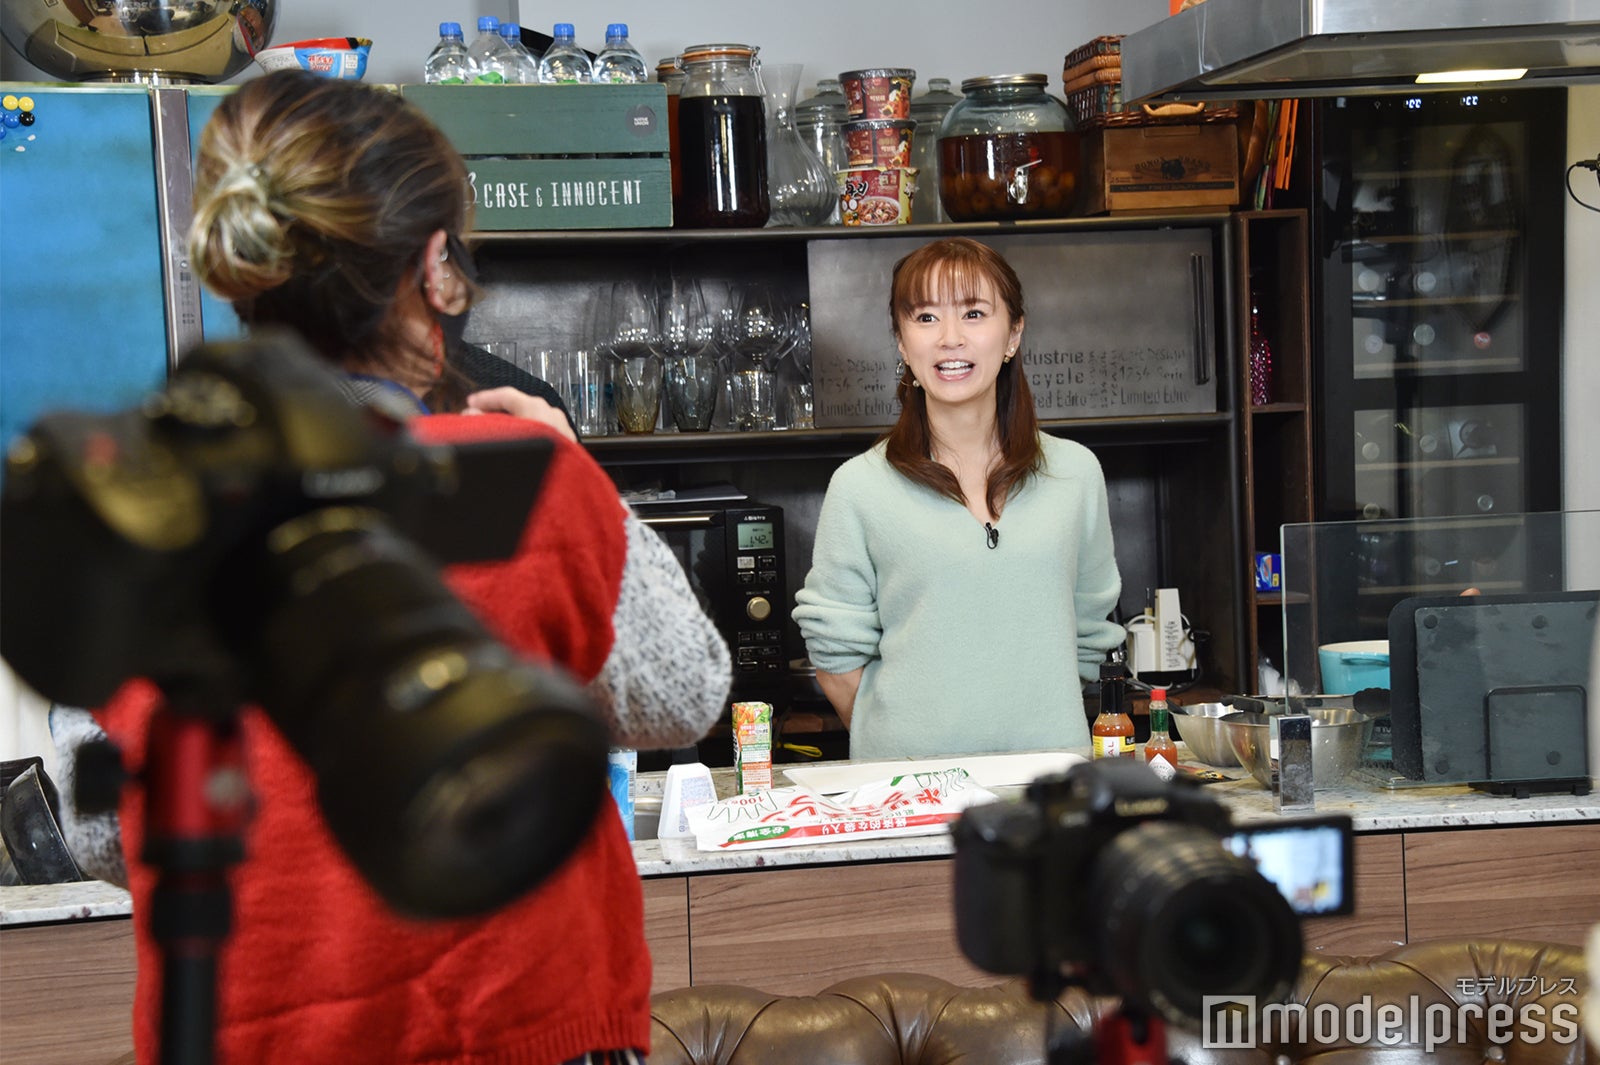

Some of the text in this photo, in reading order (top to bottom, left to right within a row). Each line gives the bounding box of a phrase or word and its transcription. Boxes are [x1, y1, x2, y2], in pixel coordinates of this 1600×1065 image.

[483, 182, 530, 208] CASE
[550, 180, 642, 207] INNOCENT
[1022, 348, 1084, 365] dustrie
[1031, 366, 1084, 388] cycle
